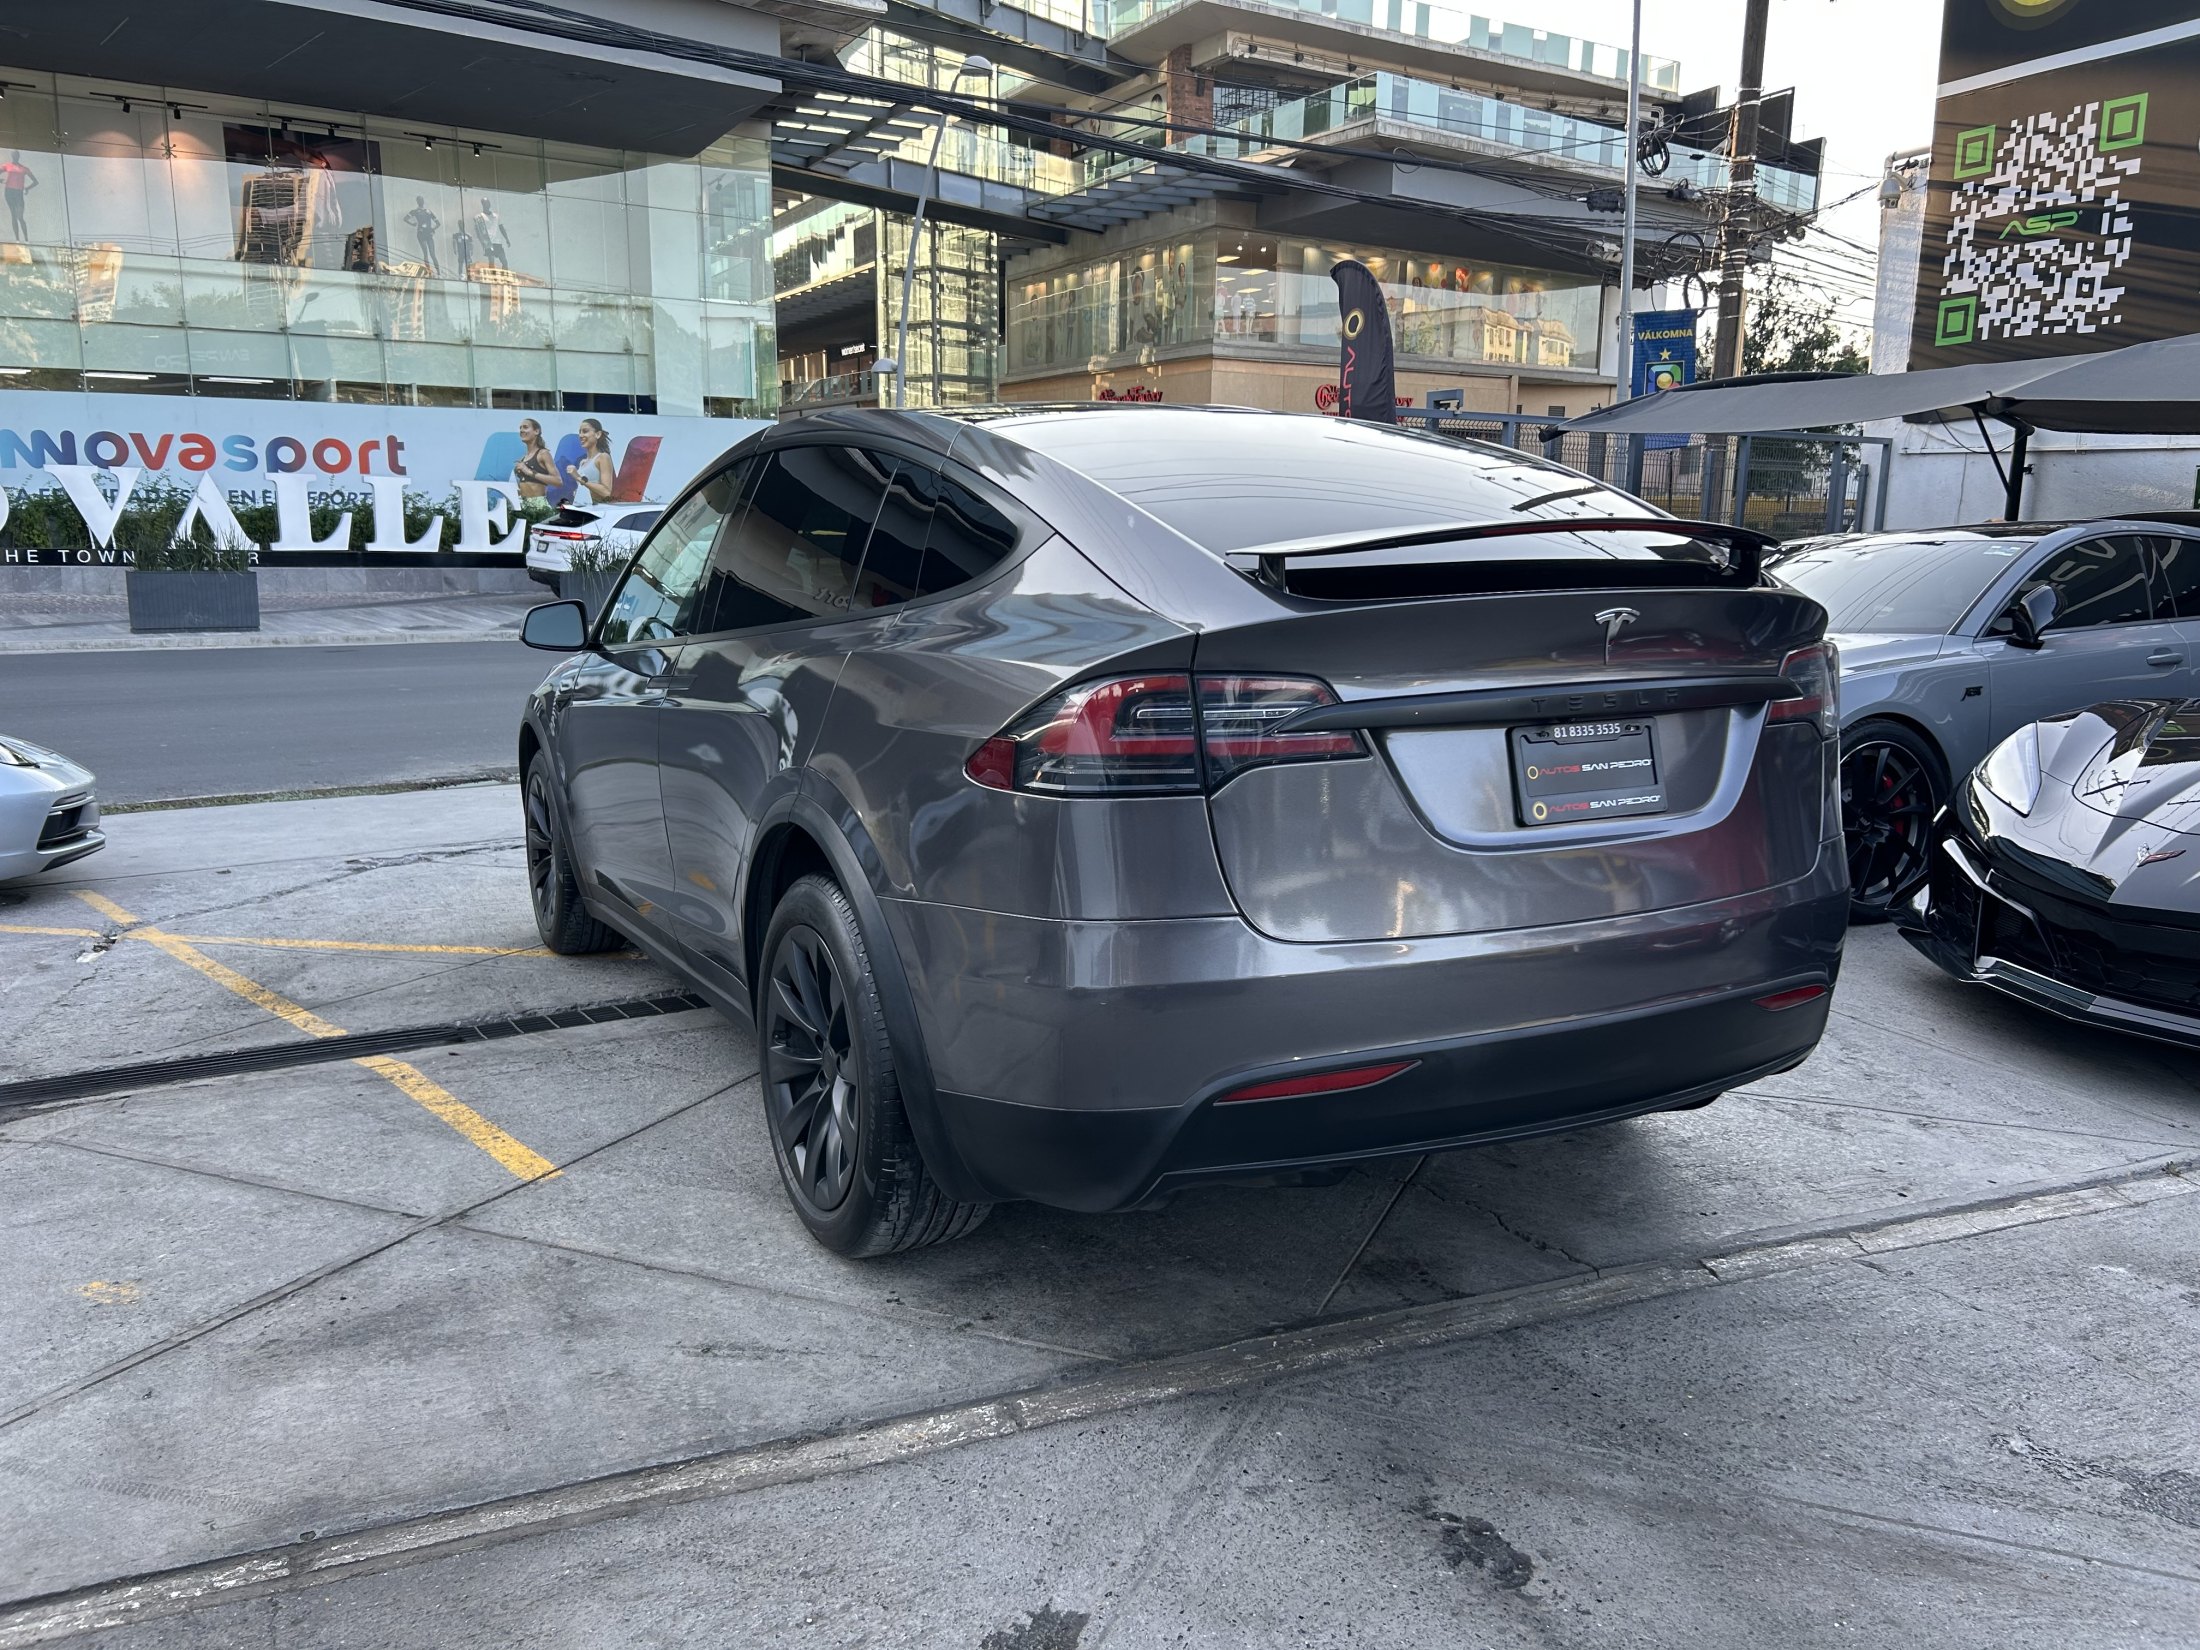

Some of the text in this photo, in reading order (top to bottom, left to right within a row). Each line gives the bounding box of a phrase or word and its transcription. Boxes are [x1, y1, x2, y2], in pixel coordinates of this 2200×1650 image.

[1998, 211, 2079, 240] ASP
[1638, 328, 1694, 341] VÄLKOMNA
[43, 463, 528, 553] VALLE
[4, 549, 138, 564] HE TOWN
[1531, 689, 1679, 713] TESLA
[1553, 722, 1621, 739] 81 8335 3535
[1539, 758, 1653, 776] AUTOS SAN PEDRO
[1548, 795, 1662, 813] AUTOS SAN PEDRO
